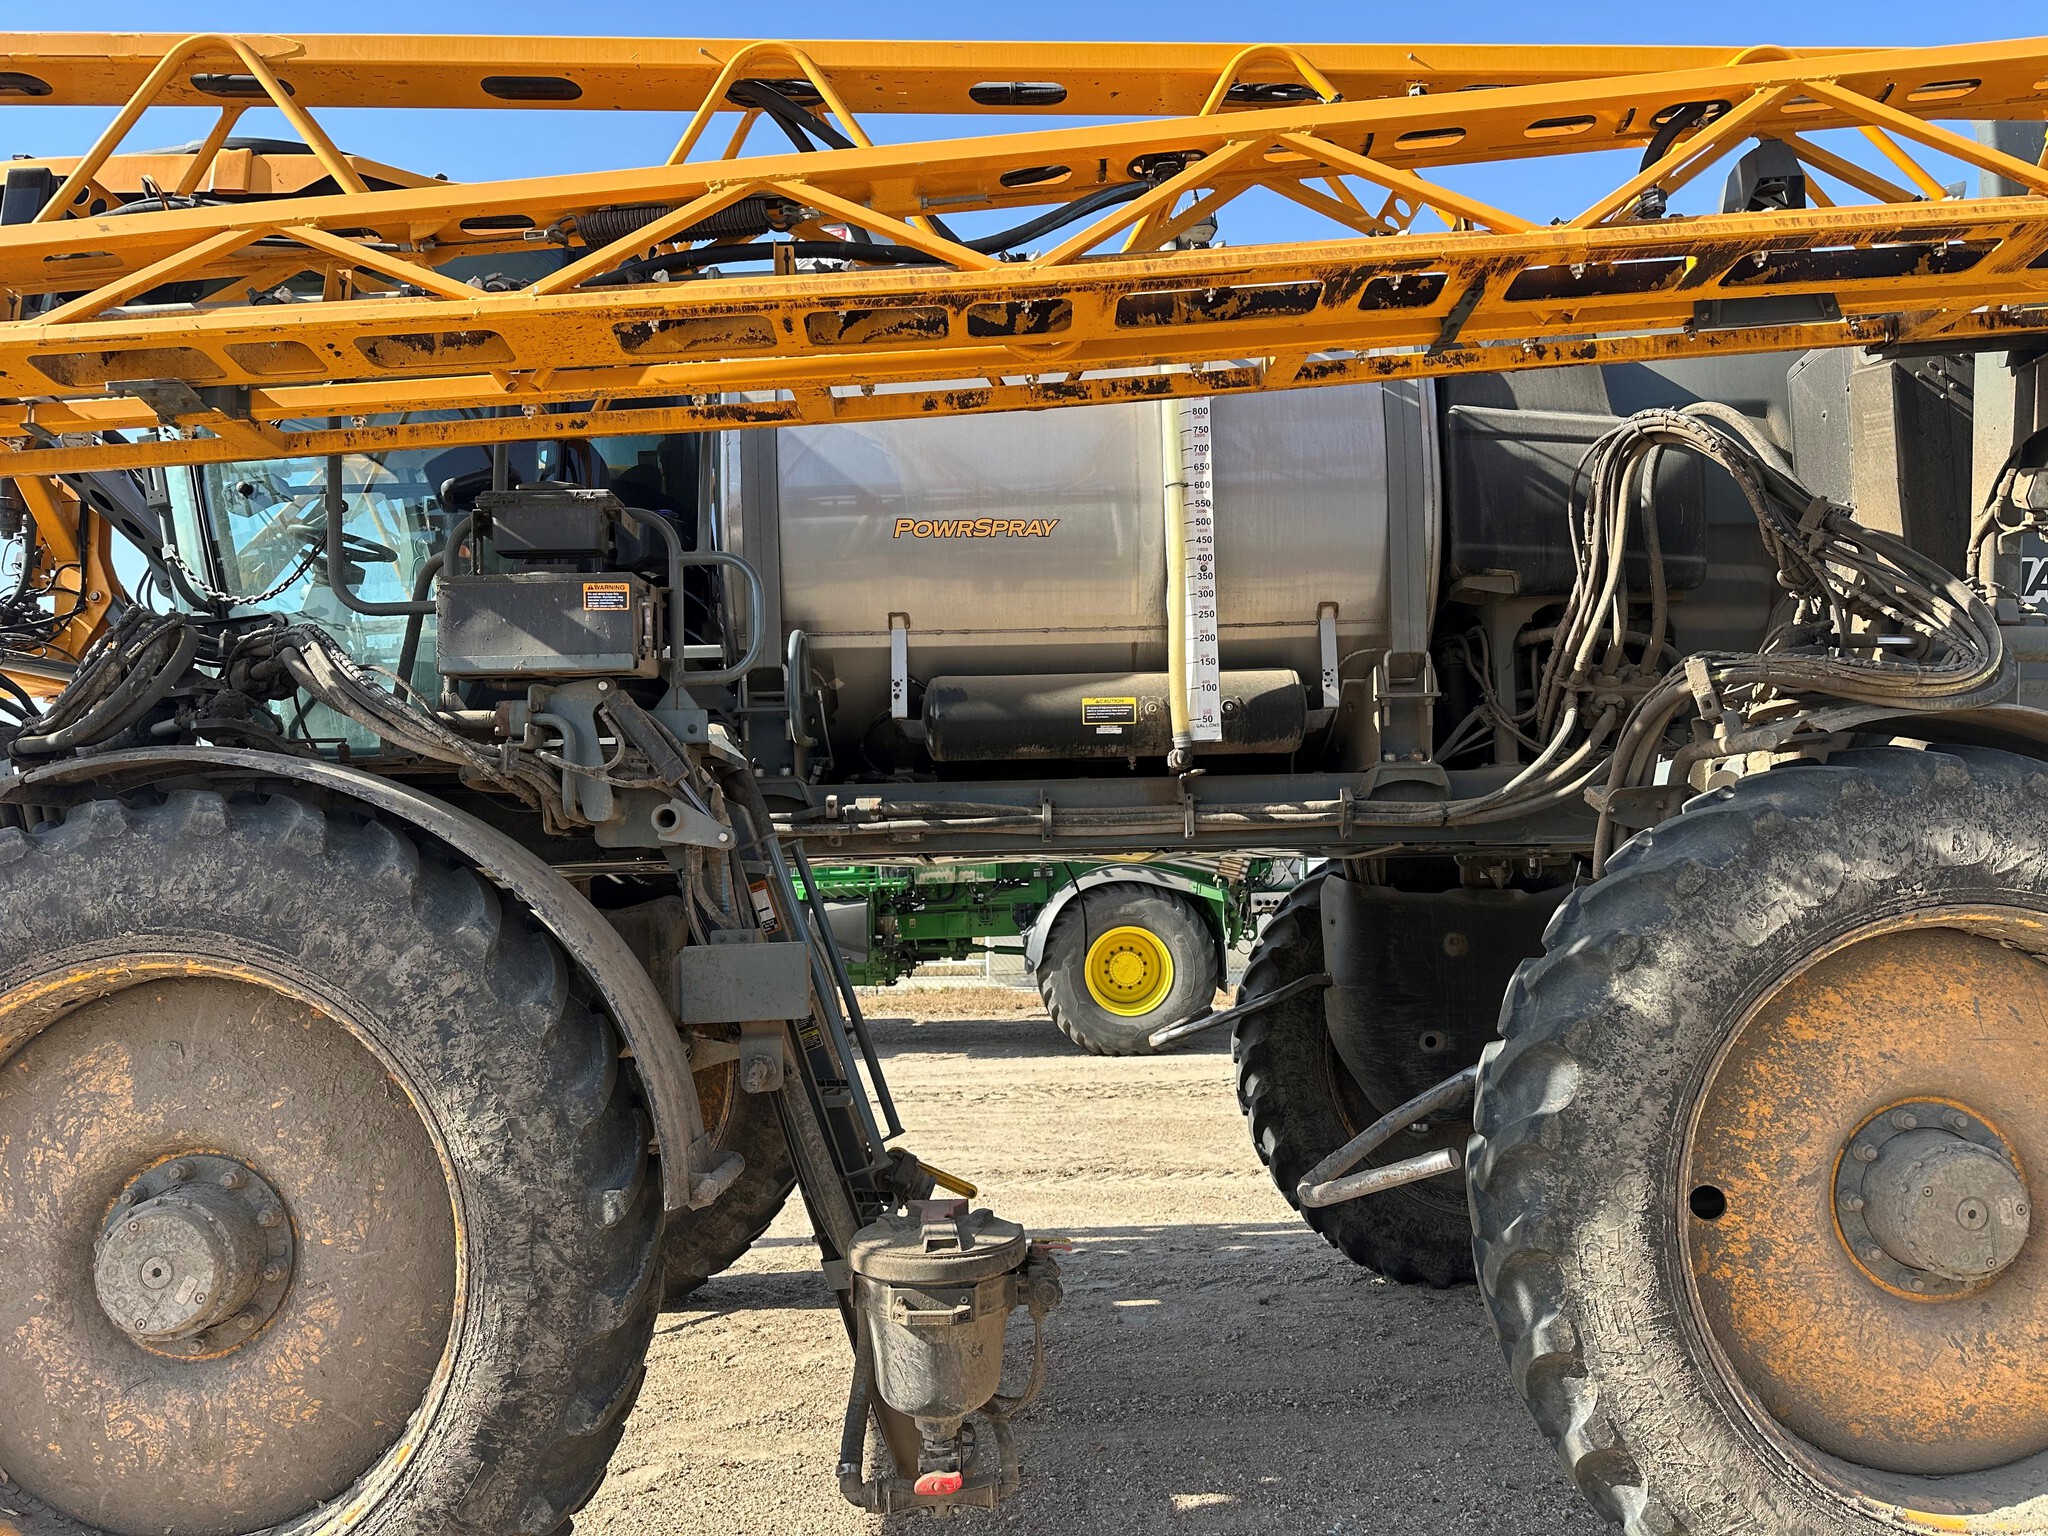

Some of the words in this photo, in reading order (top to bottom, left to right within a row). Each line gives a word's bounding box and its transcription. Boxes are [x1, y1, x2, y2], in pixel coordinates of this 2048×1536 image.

[1192, 407, 1208, 415] 800
[1193, 425, 1209, 433] 750
[1193, 444, 1209, 452] 700
[1193, 463, 1210, 471] 650
[1194, 481, 1210, 489] 600
[1196, 536, 1212, 544] 450
[1197, 572, 1213, 580] 350
[1198, 590, 1214, 598] 300
[1198, 610, 1215, 618] 250
[1199, 634, 1216, 642] 200
[1200, 657, 1216, 666] 150
[1201, 683, 1217, 692] 100
[1202, 715, 1213, 723] 50
